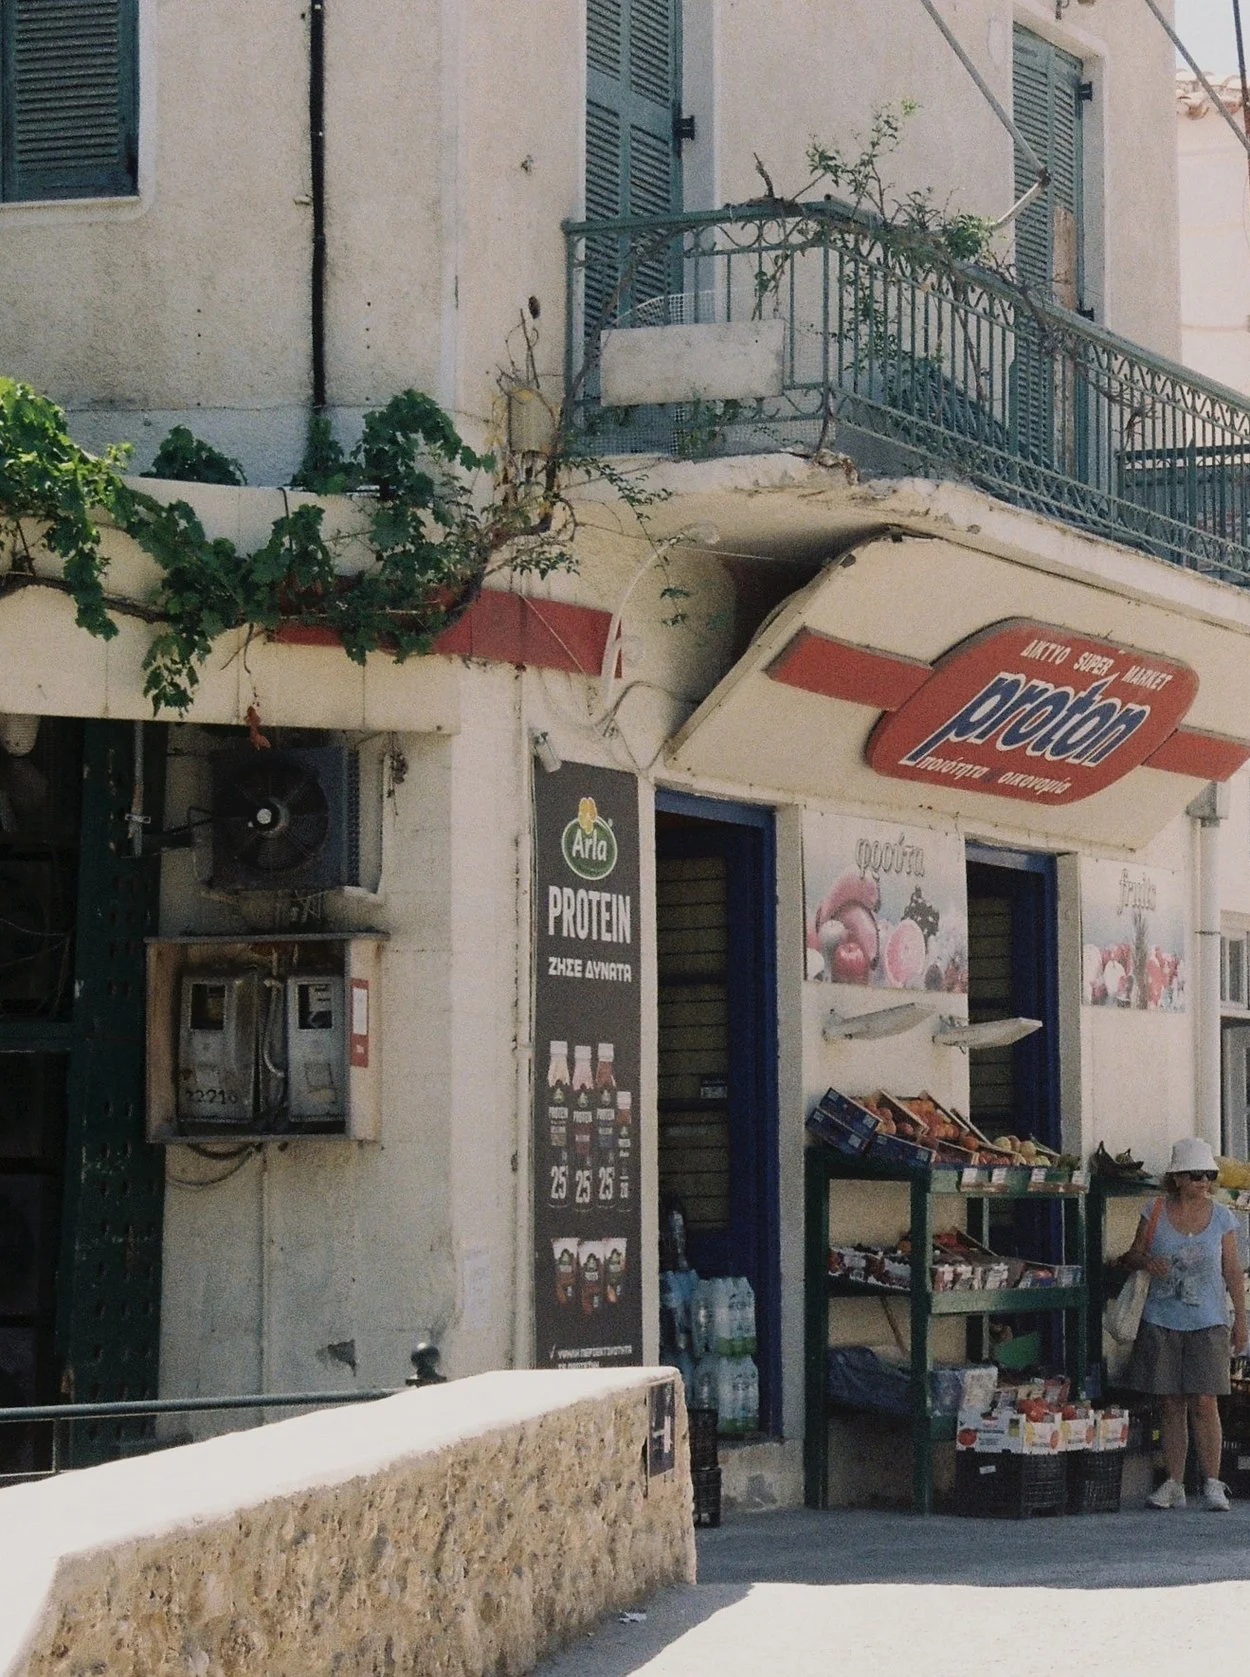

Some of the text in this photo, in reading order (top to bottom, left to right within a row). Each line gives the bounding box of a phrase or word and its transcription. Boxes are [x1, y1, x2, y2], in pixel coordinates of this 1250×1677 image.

[1020, 640, 1072, 665] ΔΙΚΤΥΟ
[1073, 651, 1174, 691] SUPER MARKET
[899, 671, 1151, 767] proton
[916, 756, 991, 780] ποιότητα
[998, 771, 1072, 796] οικονομία
[572, 828, 608, 862] Arla
[548, 885, 631, 944] PROTEIN
